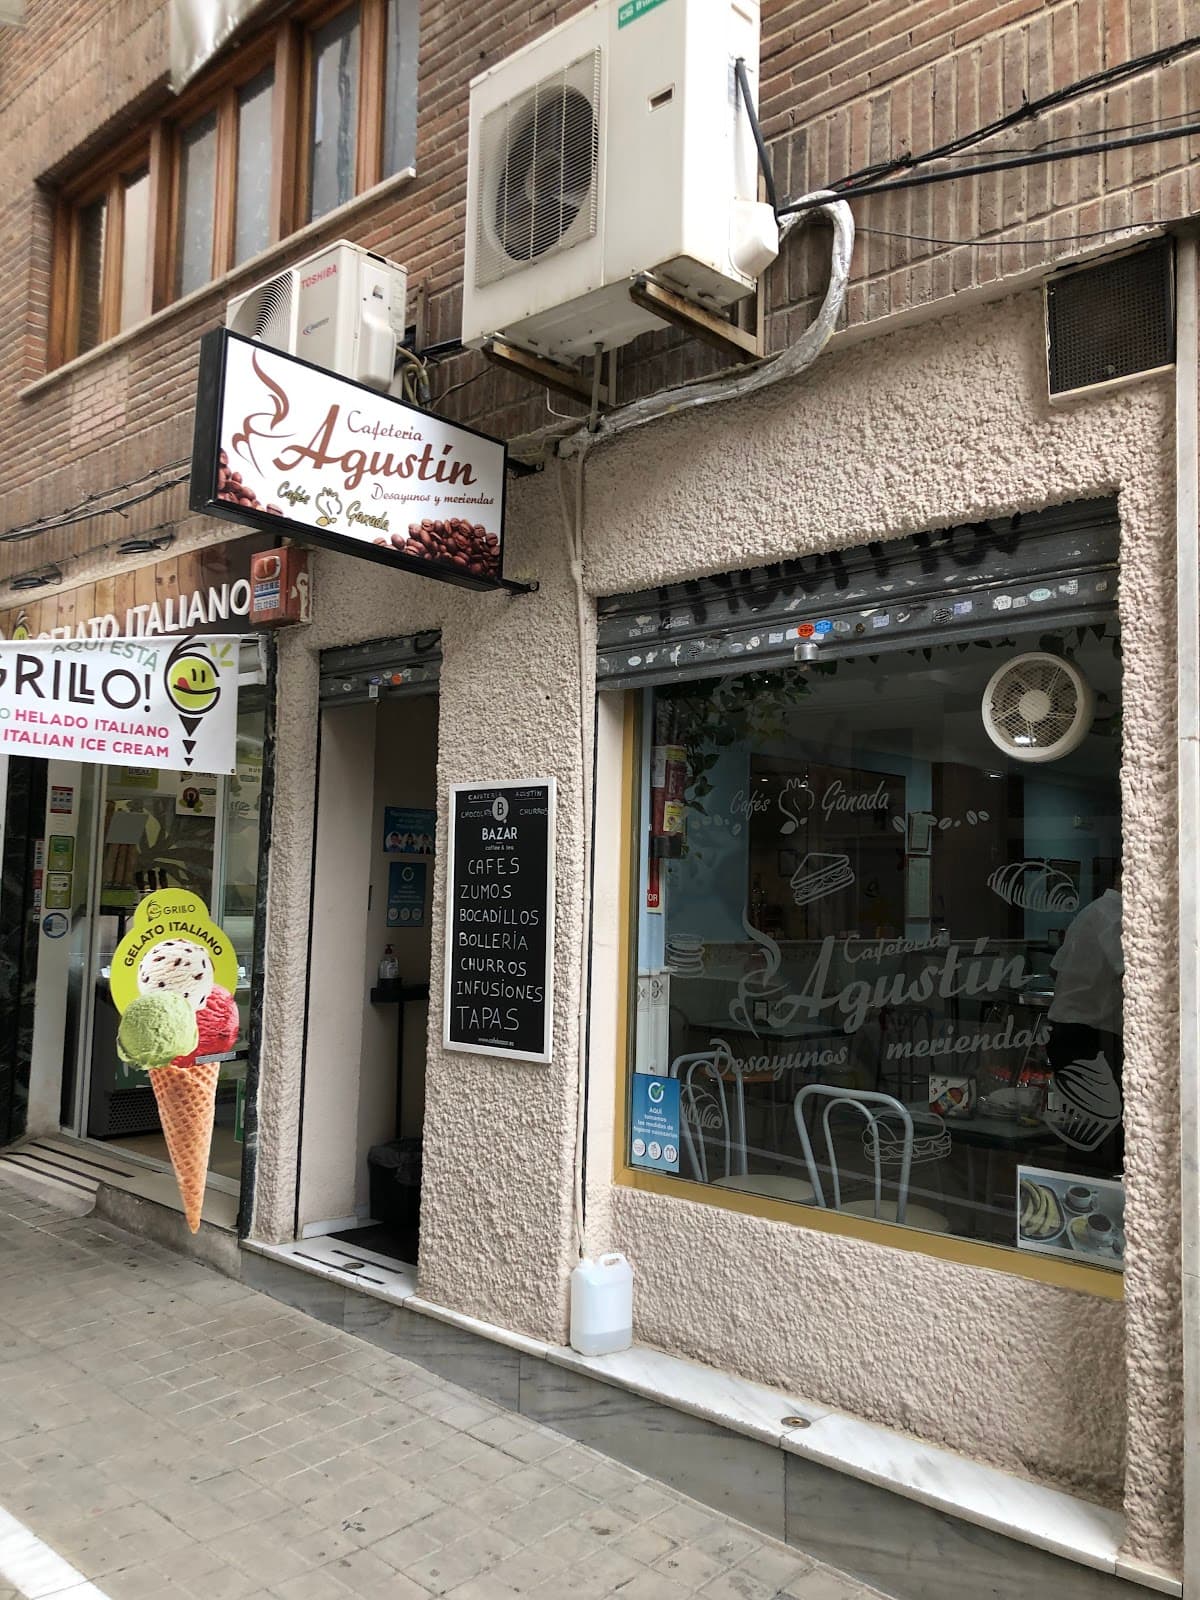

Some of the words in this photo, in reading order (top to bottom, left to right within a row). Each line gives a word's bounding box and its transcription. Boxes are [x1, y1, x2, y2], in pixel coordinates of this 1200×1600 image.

[301, 264, 337, 289] TOSHIBA
[272, 404, 476, 491] Agustín
[370, 482, 430, 504] Desayunos
[434, 496, 441, 506] y
[444, 492, 495, 505] meriendas
[126, 578, 250, 638] ITALIANO
[110, 640, 160, 672] ESTÁ
[15, 708, 88, 729] HELADO
[95, 718, 169, 739] ITALIANO
[3, 728, 74, 748] ITALIAN
[80, 738, 106, 751] ICE
[112, 741, 169, 758] CREAM
[729, 789, 771, 821] Cafés
[481, 827, 518, 841] BAZAR
[468, 857, 520, 875] CAFES
[460, 884, 512, 899] ZUMOS
[124, 924, 164, 967] GELATO
[169, 921, 223, 956] ITALIANO
[461, 957, 527, 977] CHURROS
[767, 935, 1034, 1034] Agustín
[456, 1005, 520, 1031] TAPAS
[706, 1038, 848, 1081] Desayunos
[886, 1015, 1054, 1060] meriendas
